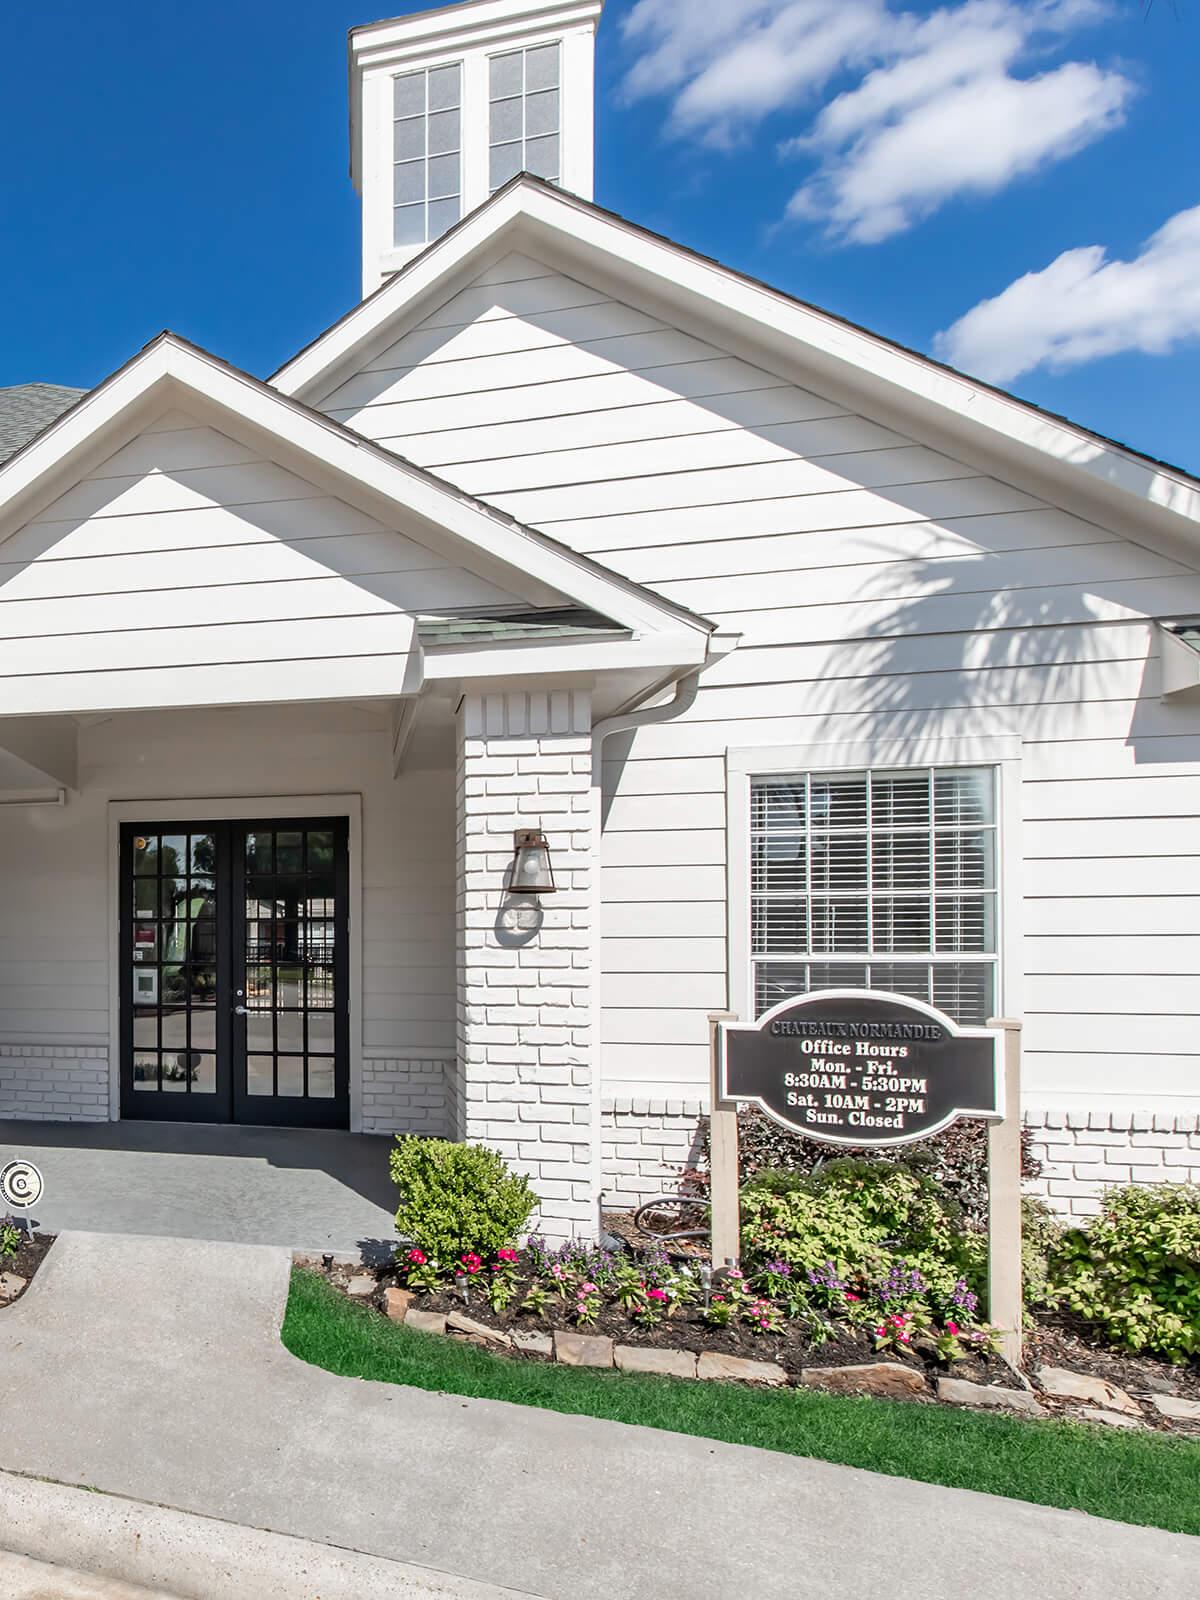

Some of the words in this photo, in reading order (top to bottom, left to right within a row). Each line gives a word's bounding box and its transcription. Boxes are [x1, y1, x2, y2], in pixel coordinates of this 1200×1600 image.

[771, 1021, 846, 1036] CHATEAUX
[850, 1023, 942, 1040] NORMANDIE
[801, 1040, 850, 1056] Office
[856, 1042, 908, 1057] Hours
[810, 1058, 850, 1073] Mon.
[867, 1062, 898, 1076] Fri.
[784, 1074, 846, 1090] 8:30AM
[862, 1076, 927, 1093] 5:30PM
[787, 1092, 818, 1107] Sat.
[824, 1094, 870, 1110] 10AM
[886, 1098, 924, 1113] 2PM
[806, 1110, 843, 1125] Sun.
[848, 1112, 904, 1128] Closed
